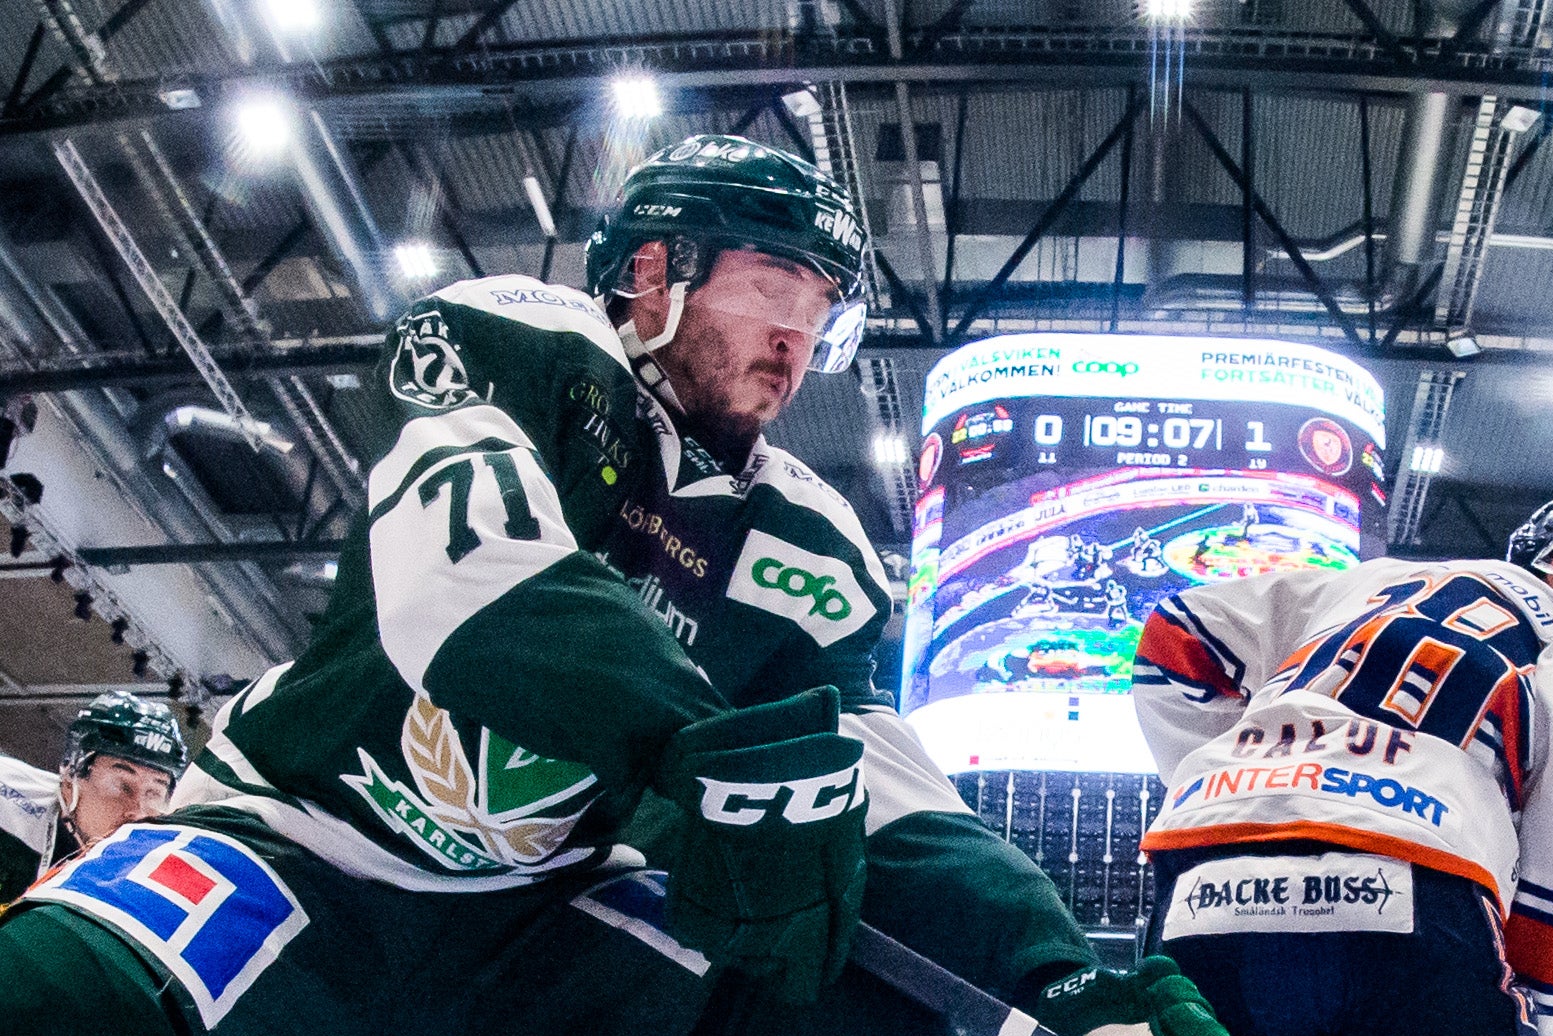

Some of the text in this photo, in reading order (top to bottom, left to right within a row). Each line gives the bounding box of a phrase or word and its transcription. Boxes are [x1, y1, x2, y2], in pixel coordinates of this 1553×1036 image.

[1072, 361, 1139, 378] coop
[1157, 402, 1193, 415] TIME
[1245, 421, 1272, 451] 1
[1116, 453, 1171, 466] PERIOD
[418, 452, 542, 565] 71
[751, 557, 852, 621] coop
[1203, 762, 1450, 828] INTERSPORT
[1046, 968, 1099, 999] CCM
